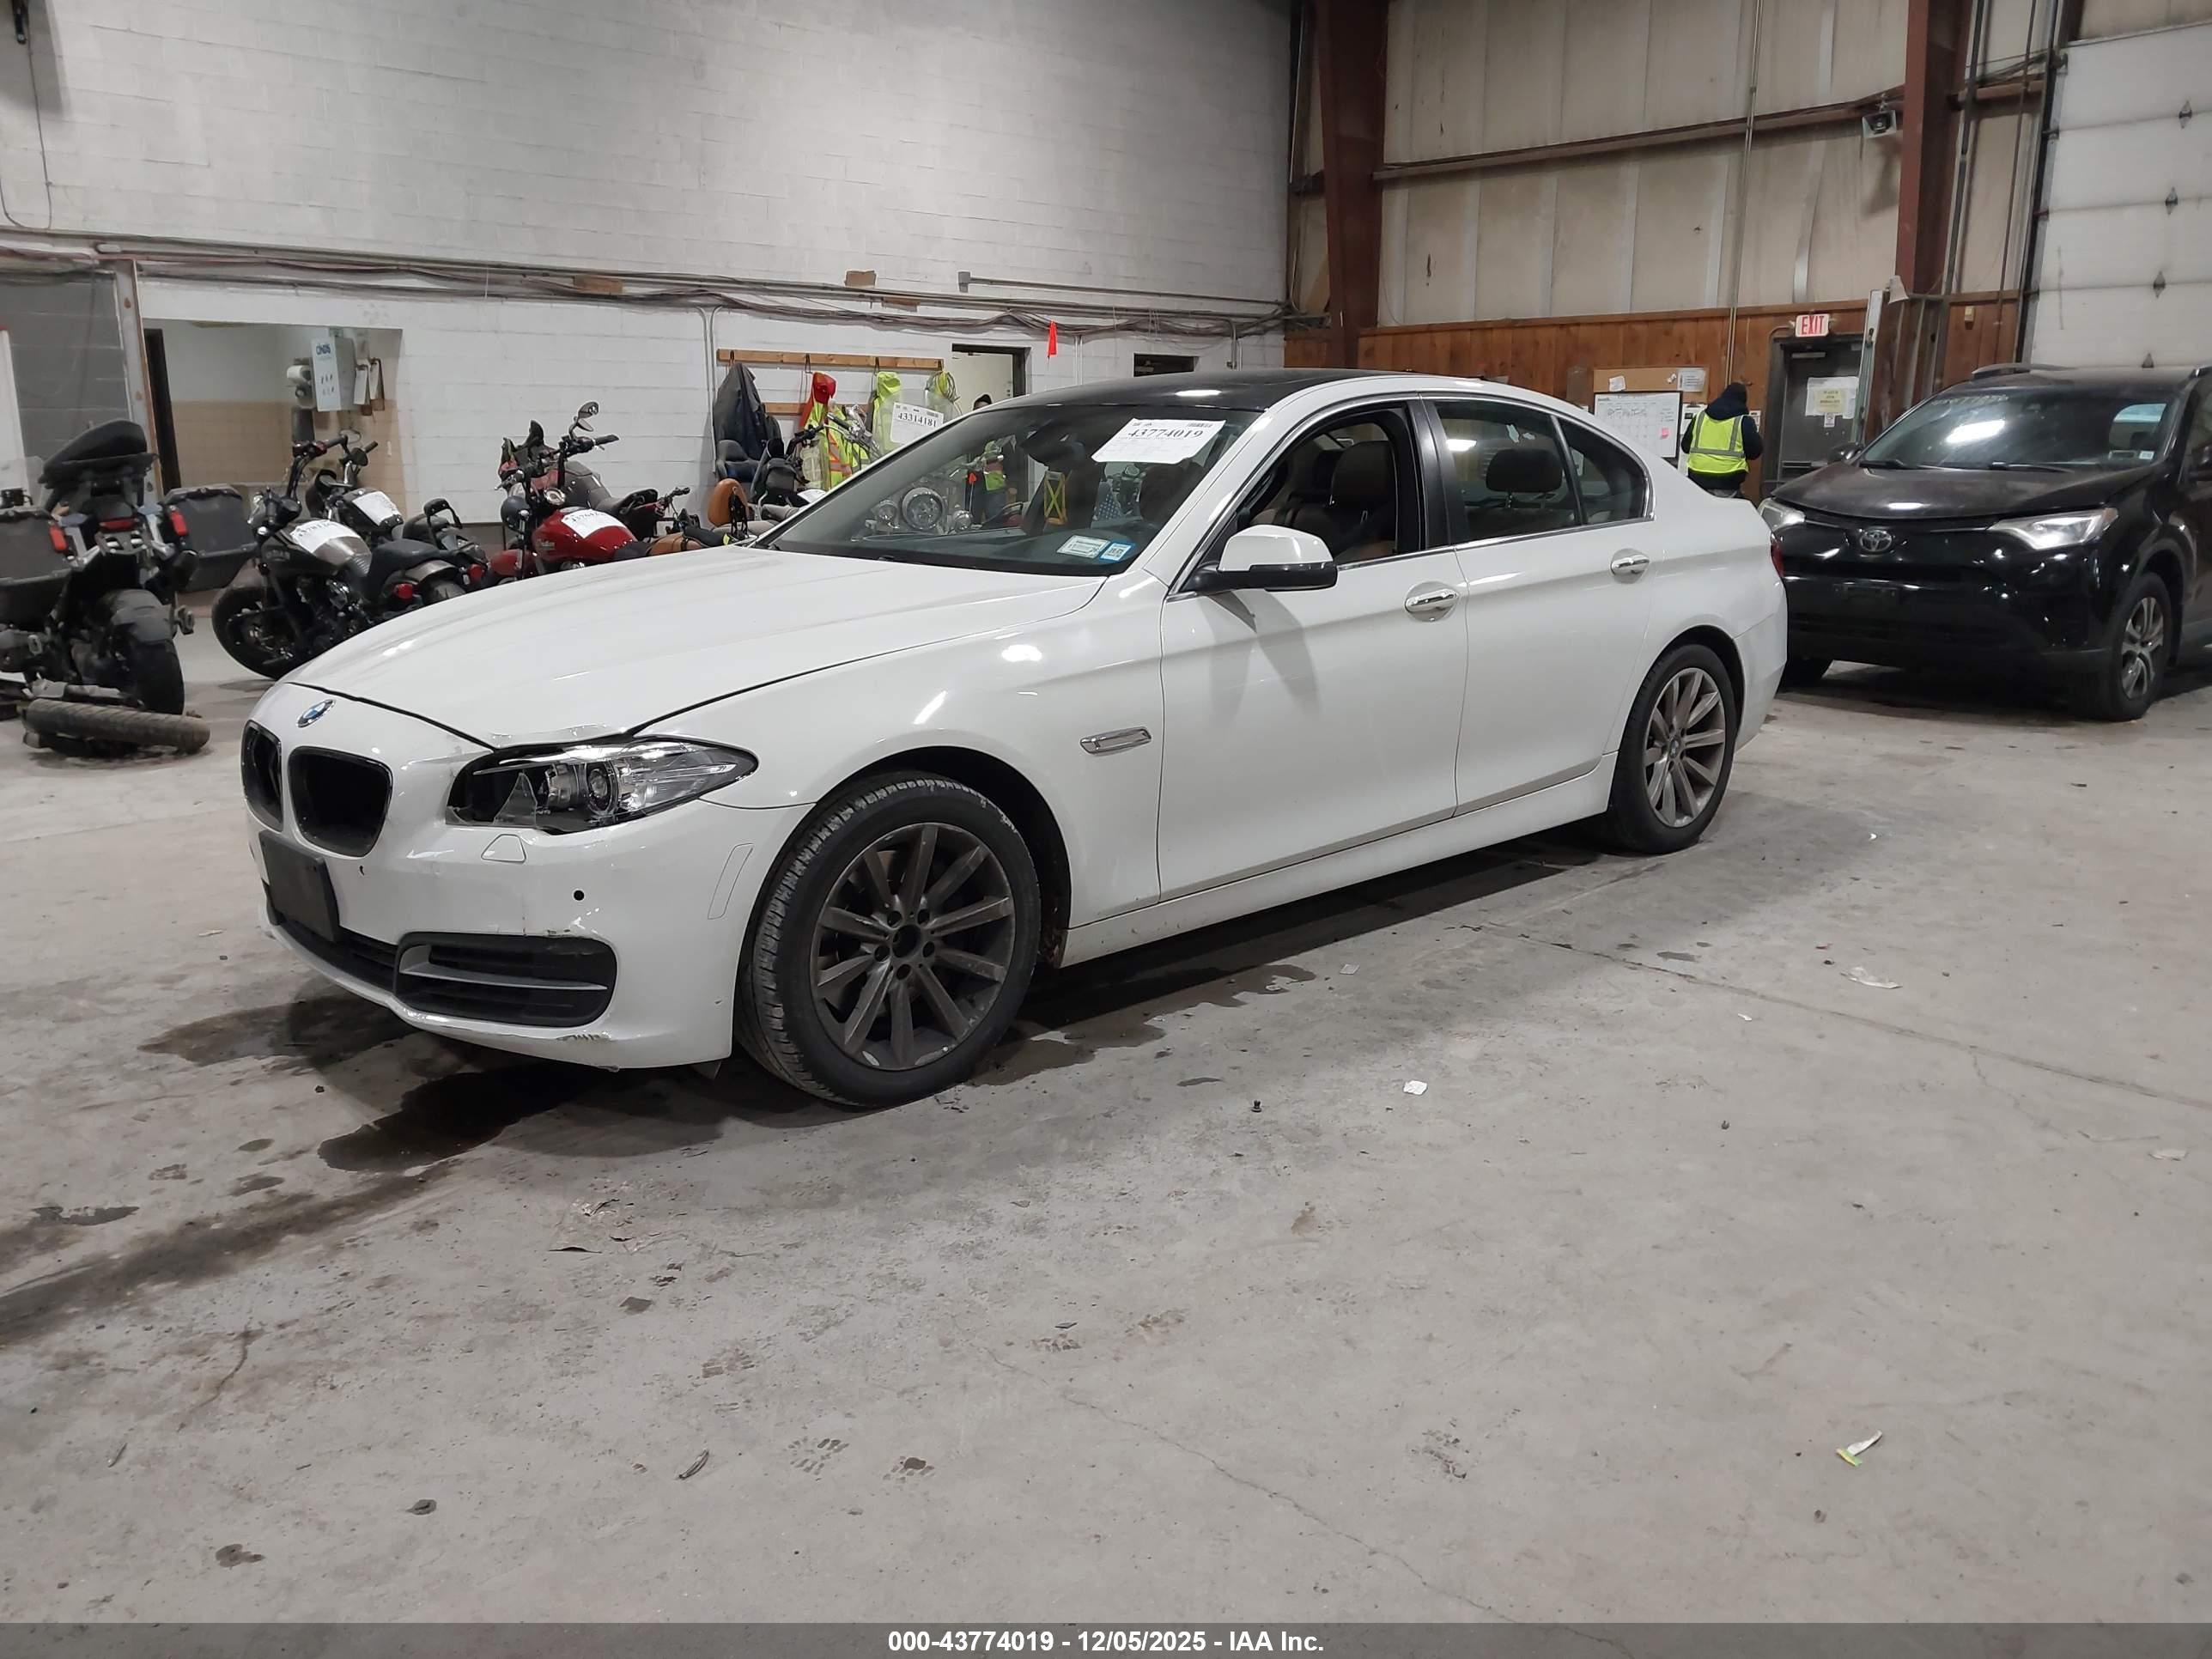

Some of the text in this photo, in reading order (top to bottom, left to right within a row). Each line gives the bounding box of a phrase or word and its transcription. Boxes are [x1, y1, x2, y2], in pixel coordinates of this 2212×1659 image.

[1802, 315, 1825, 335] EXIT
[898, 412, 936, 428] 43314181
[1128, 429, 1204, 439] 43774019
